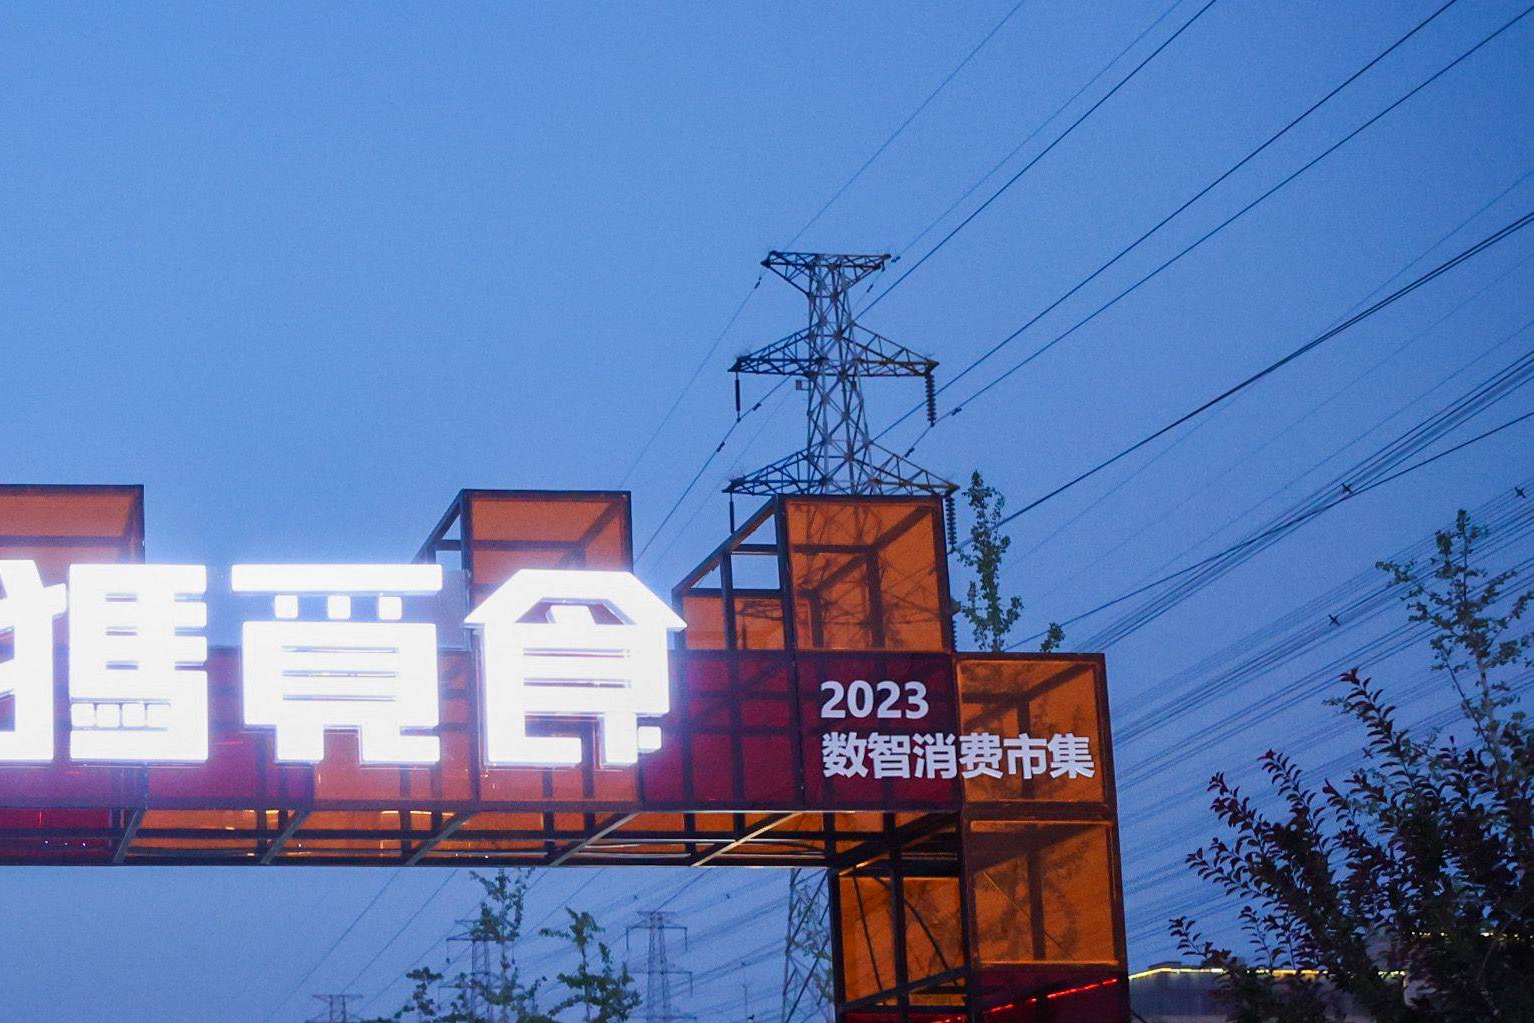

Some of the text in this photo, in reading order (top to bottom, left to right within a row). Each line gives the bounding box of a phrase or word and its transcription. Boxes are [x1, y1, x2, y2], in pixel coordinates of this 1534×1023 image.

[820, 680, 929, 720] 2023
[821, 731, 1096, 780] 数智消费市集
